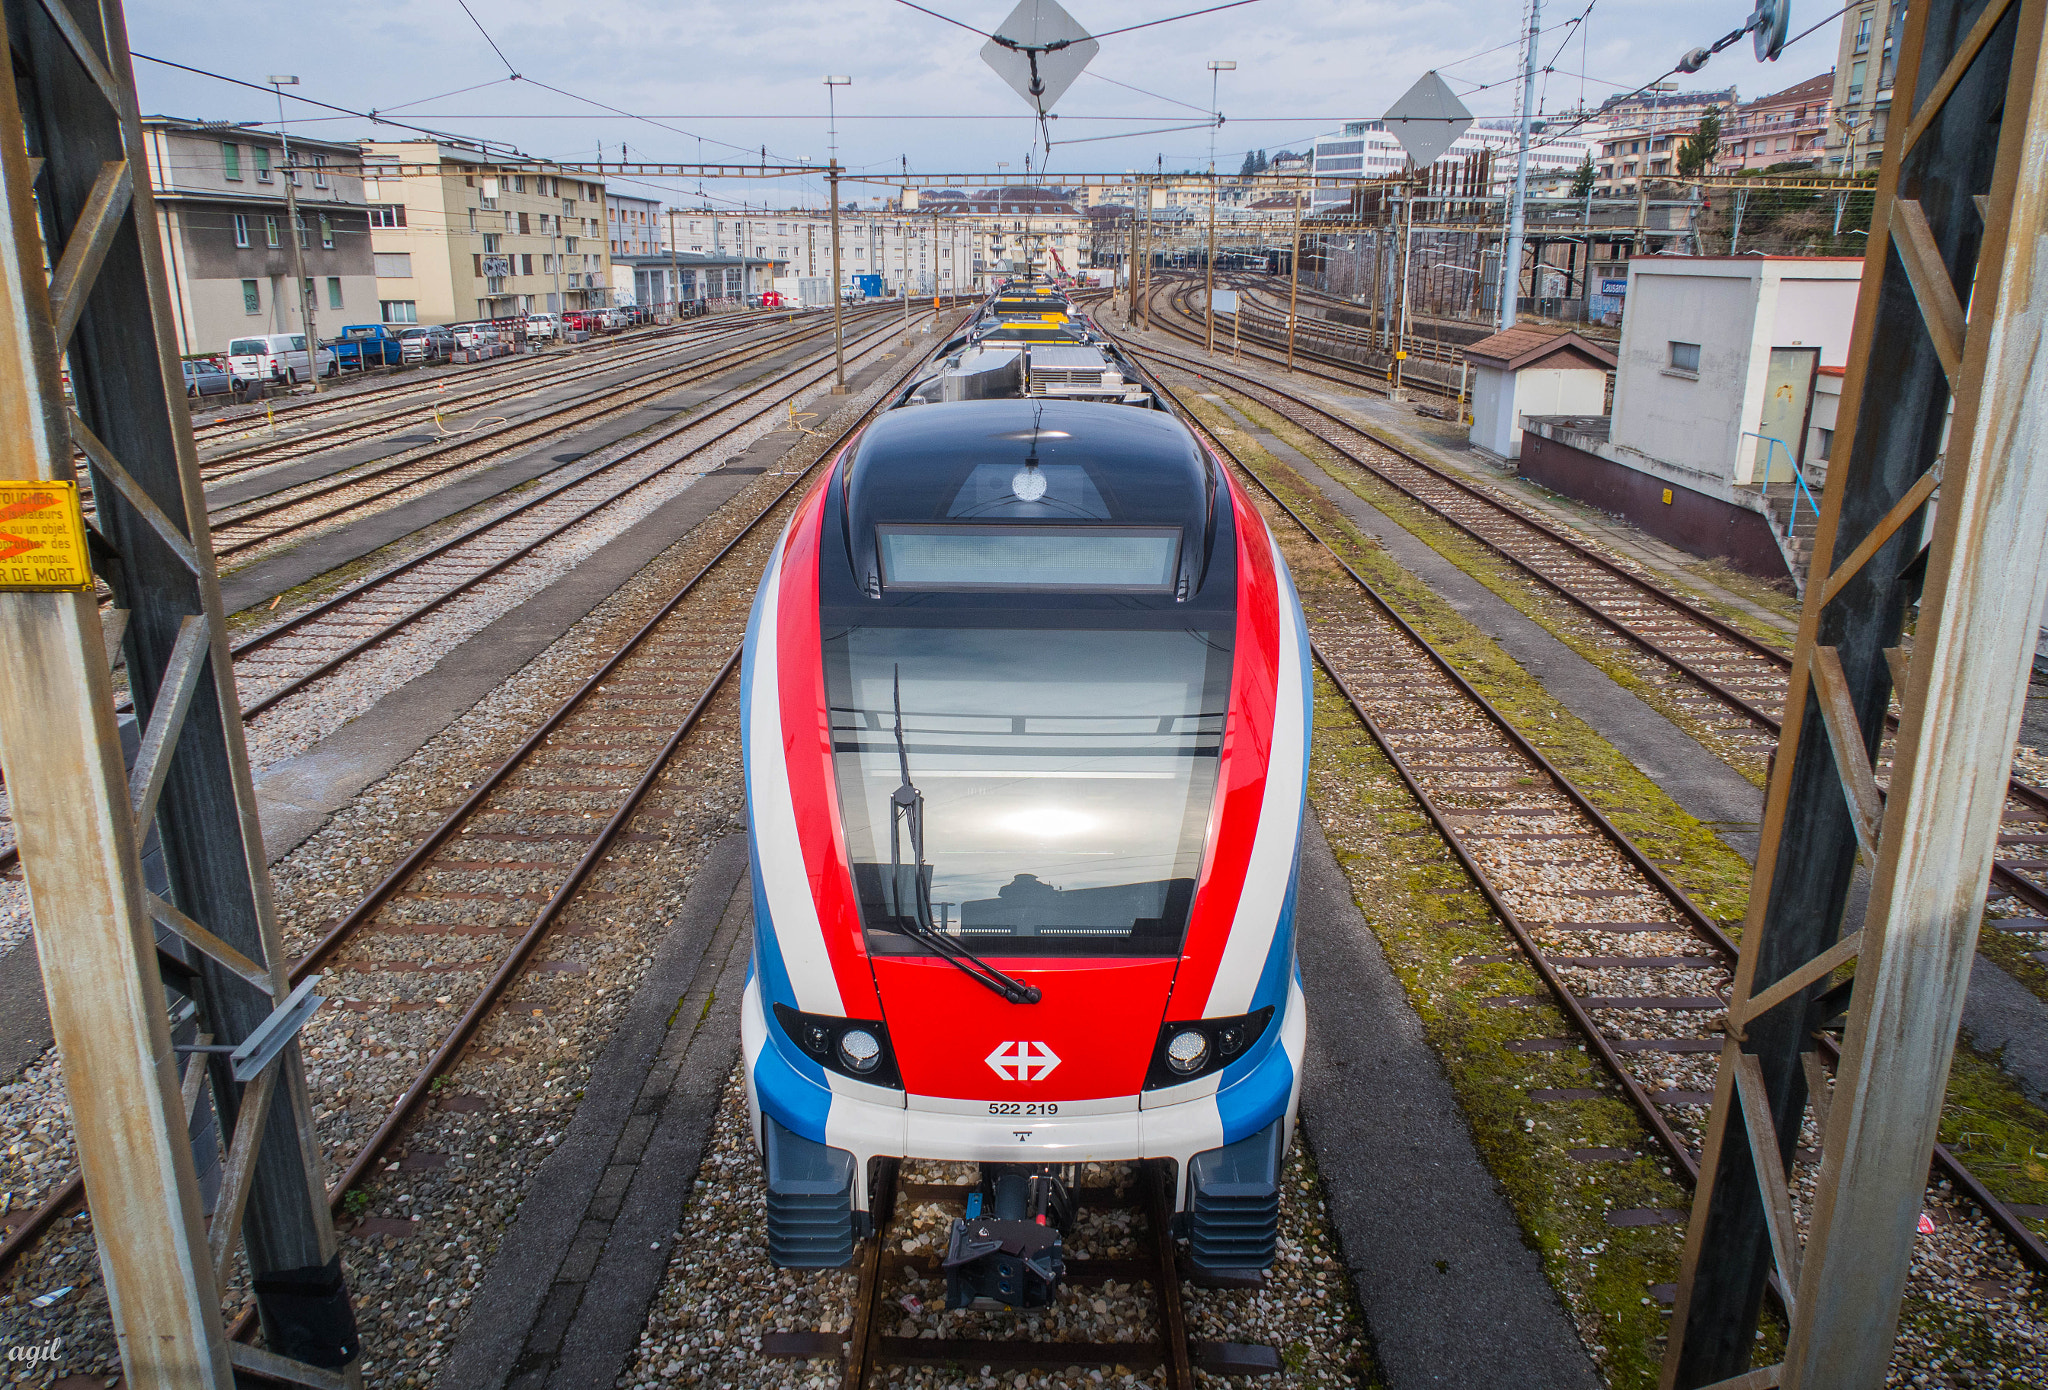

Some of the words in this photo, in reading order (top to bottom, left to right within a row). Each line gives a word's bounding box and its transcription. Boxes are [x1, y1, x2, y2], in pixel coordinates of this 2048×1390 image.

[8, 508, 64, 519] isolateurs
[11, 525, 23, 534] ou
[26, 525, 39, 535] un
[51, 538, 71, 549] des
[11, 555, 24, 564] ou
[12, 568, 31, 582] DE
[35, 568, 75, 582] MORT
[988, 1103, 1021, 1115] 522
[1026, 1103, 1058, 1115] 219
